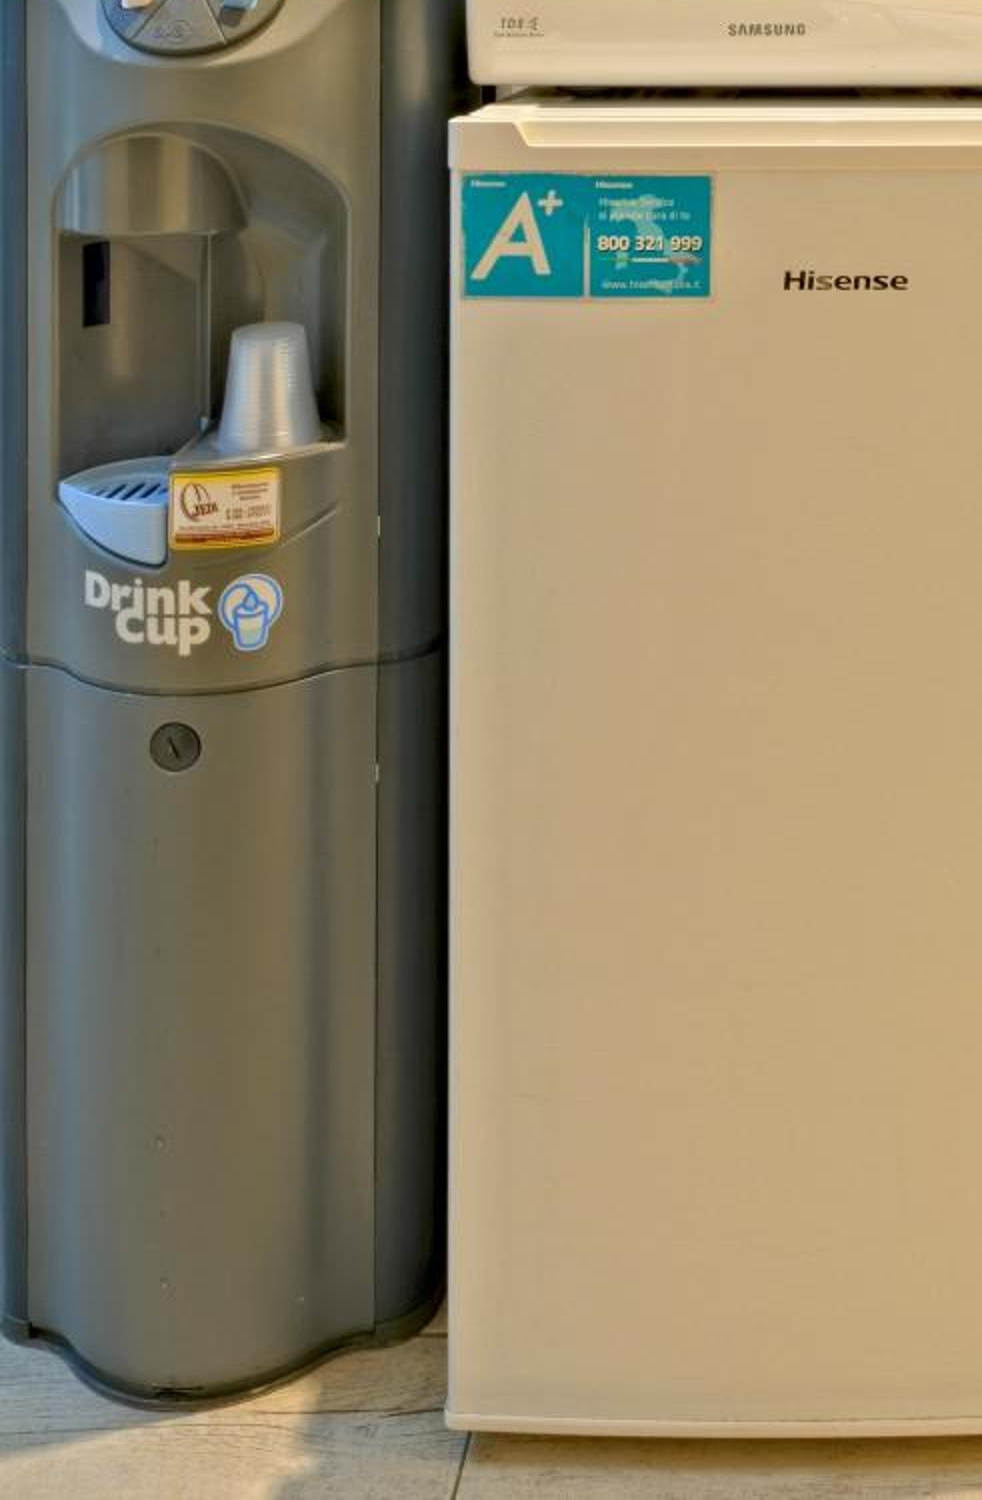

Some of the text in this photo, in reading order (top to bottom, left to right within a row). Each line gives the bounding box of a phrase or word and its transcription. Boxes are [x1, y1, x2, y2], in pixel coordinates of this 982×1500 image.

[727, 22, 806, 36] SAMSUNG
[597, 235, 703, 251] 800 321 999
[783, 270, 909, 291] Hisense
[84, 569, 213, 616] Drink
[114, 607, 211, 656] Cup
